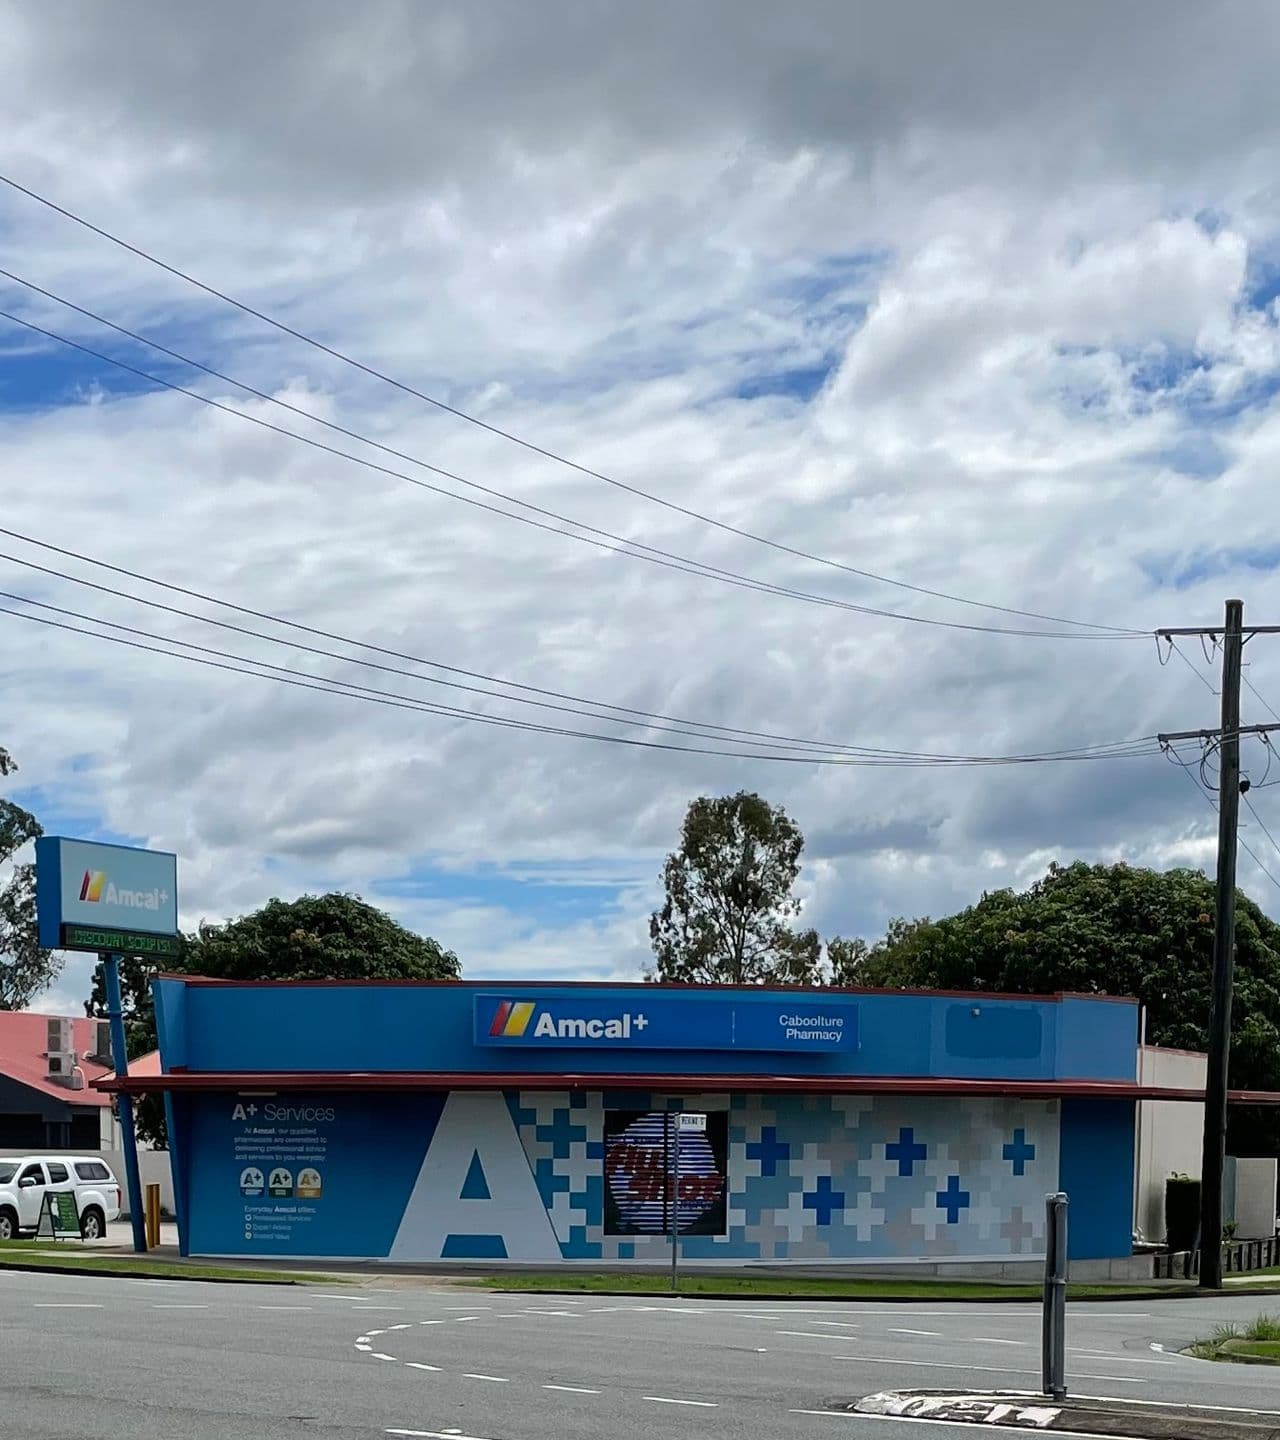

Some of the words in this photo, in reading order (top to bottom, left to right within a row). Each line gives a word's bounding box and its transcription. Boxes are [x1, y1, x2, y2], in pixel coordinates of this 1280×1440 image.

[534, 1013, 648, 1039] Amcal+
[779, 1015, 844, 1028] Caboolture
[786, 1028, 843, 1042] Pharmacy
[232, 1103, 258, 1121] A+
[264, 1103, 335, 1121] Services
[243, 1173, 261, 1185] A+
[272, 1173, 290, 1185] A+
[300, 1173, 319, 1185] A+
